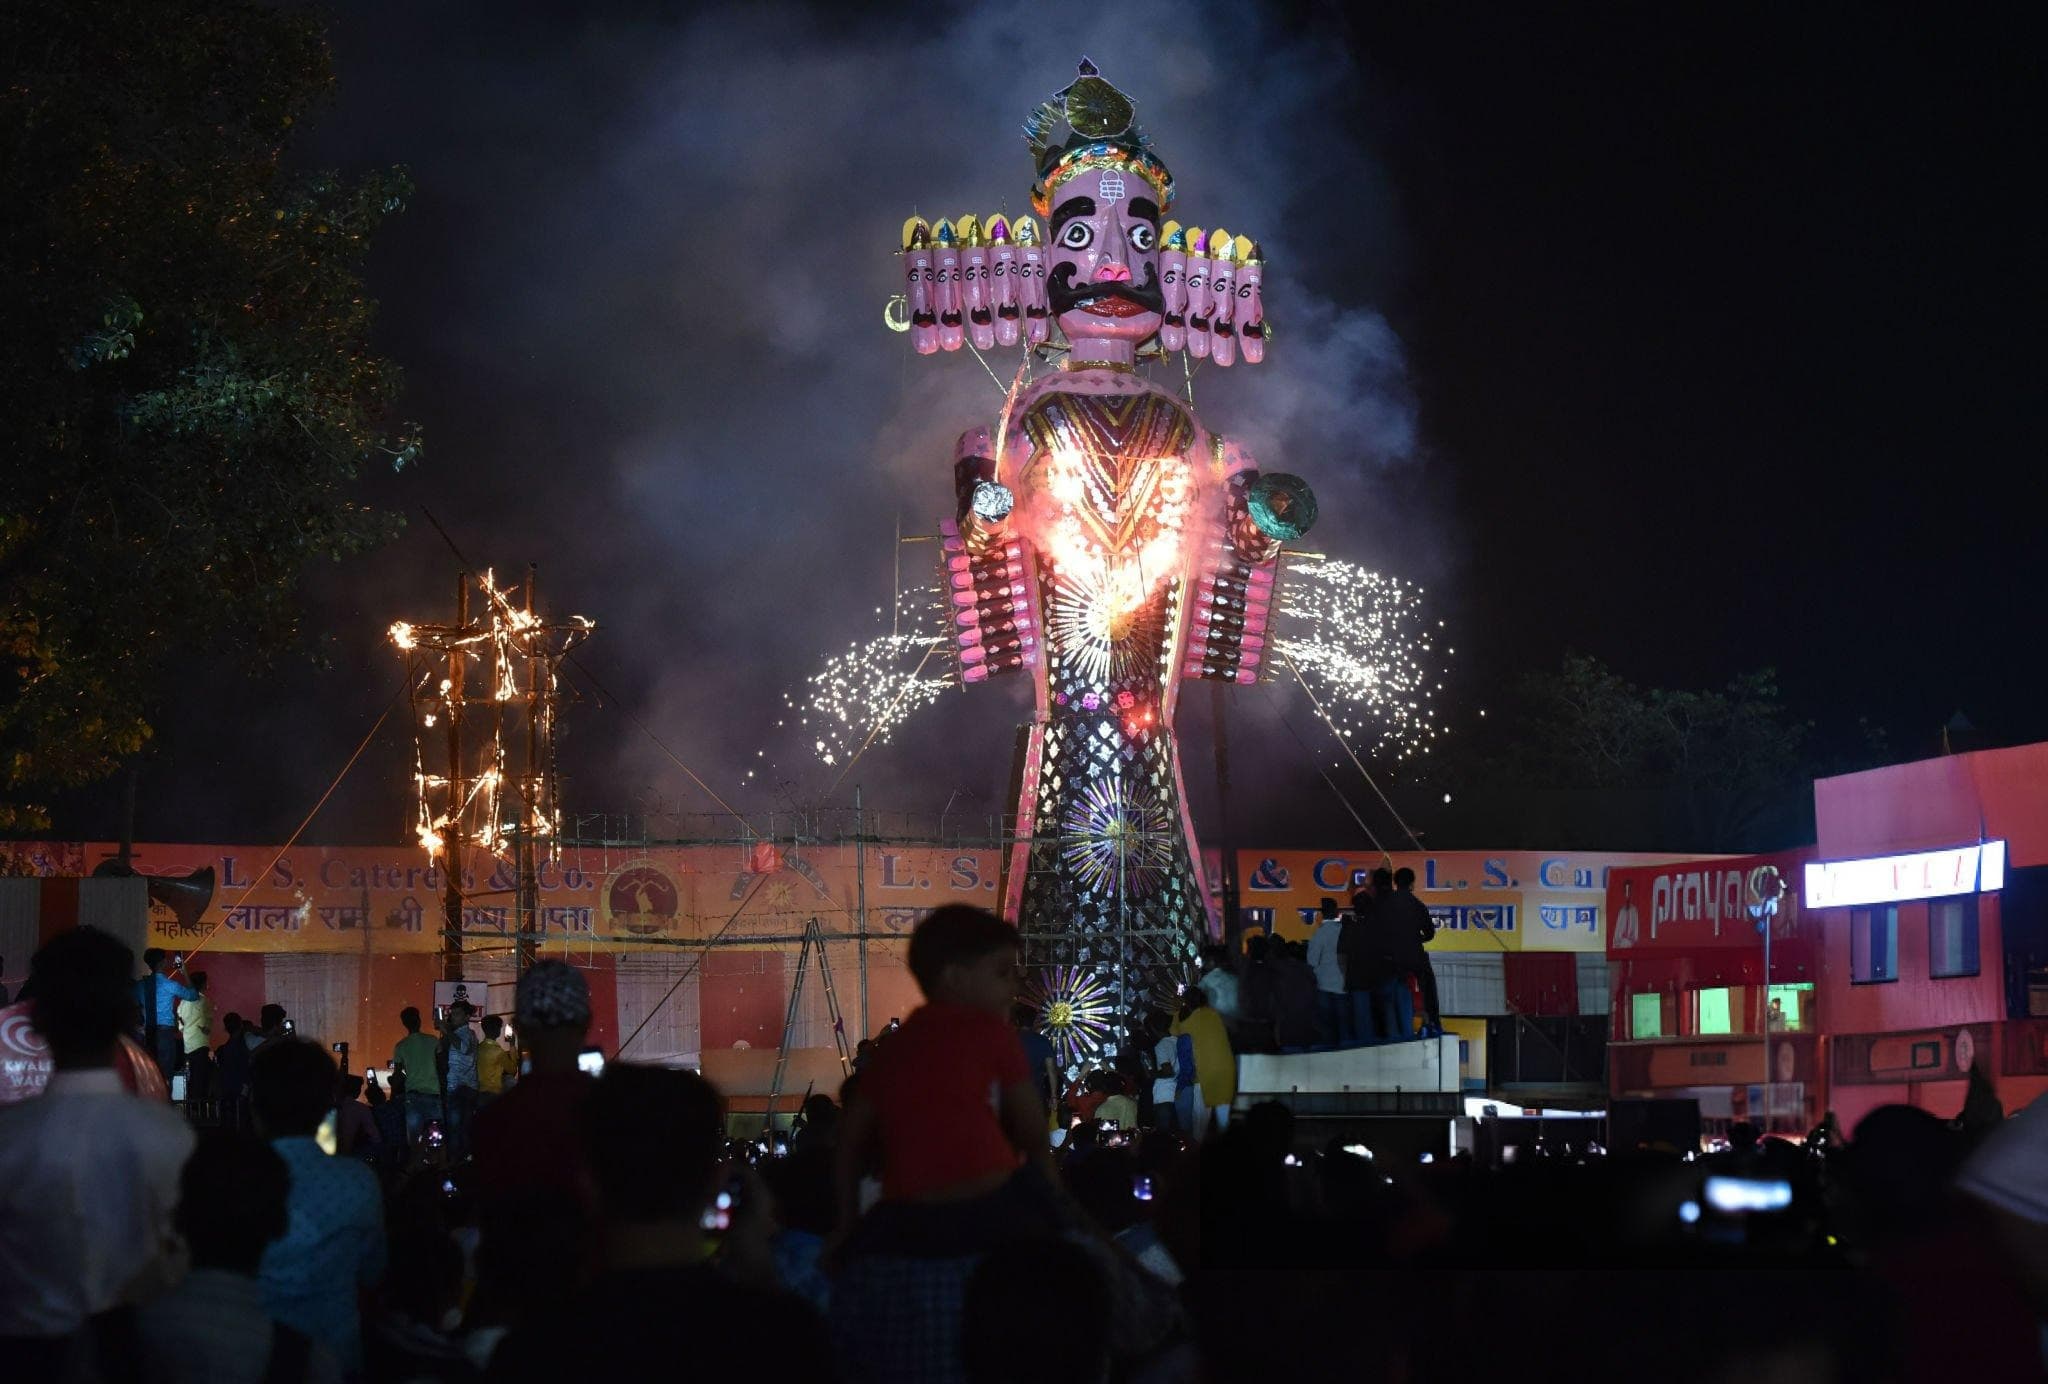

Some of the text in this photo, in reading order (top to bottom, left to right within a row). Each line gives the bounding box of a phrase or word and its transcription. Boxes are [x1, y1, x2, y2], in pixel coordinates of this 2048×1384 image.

[221, 856, 256, 888] L.
[271, 857, 304, 889] S.
[319, 858, 476, 891] Cateres
[879, 854, 931, 890] L.
[951, 856, 995, 890] S.
[1248, 858, 1291, 891] &
[1651, 868, 1768, 938] praya
[4, 1059, 53, 1074] KWALI
